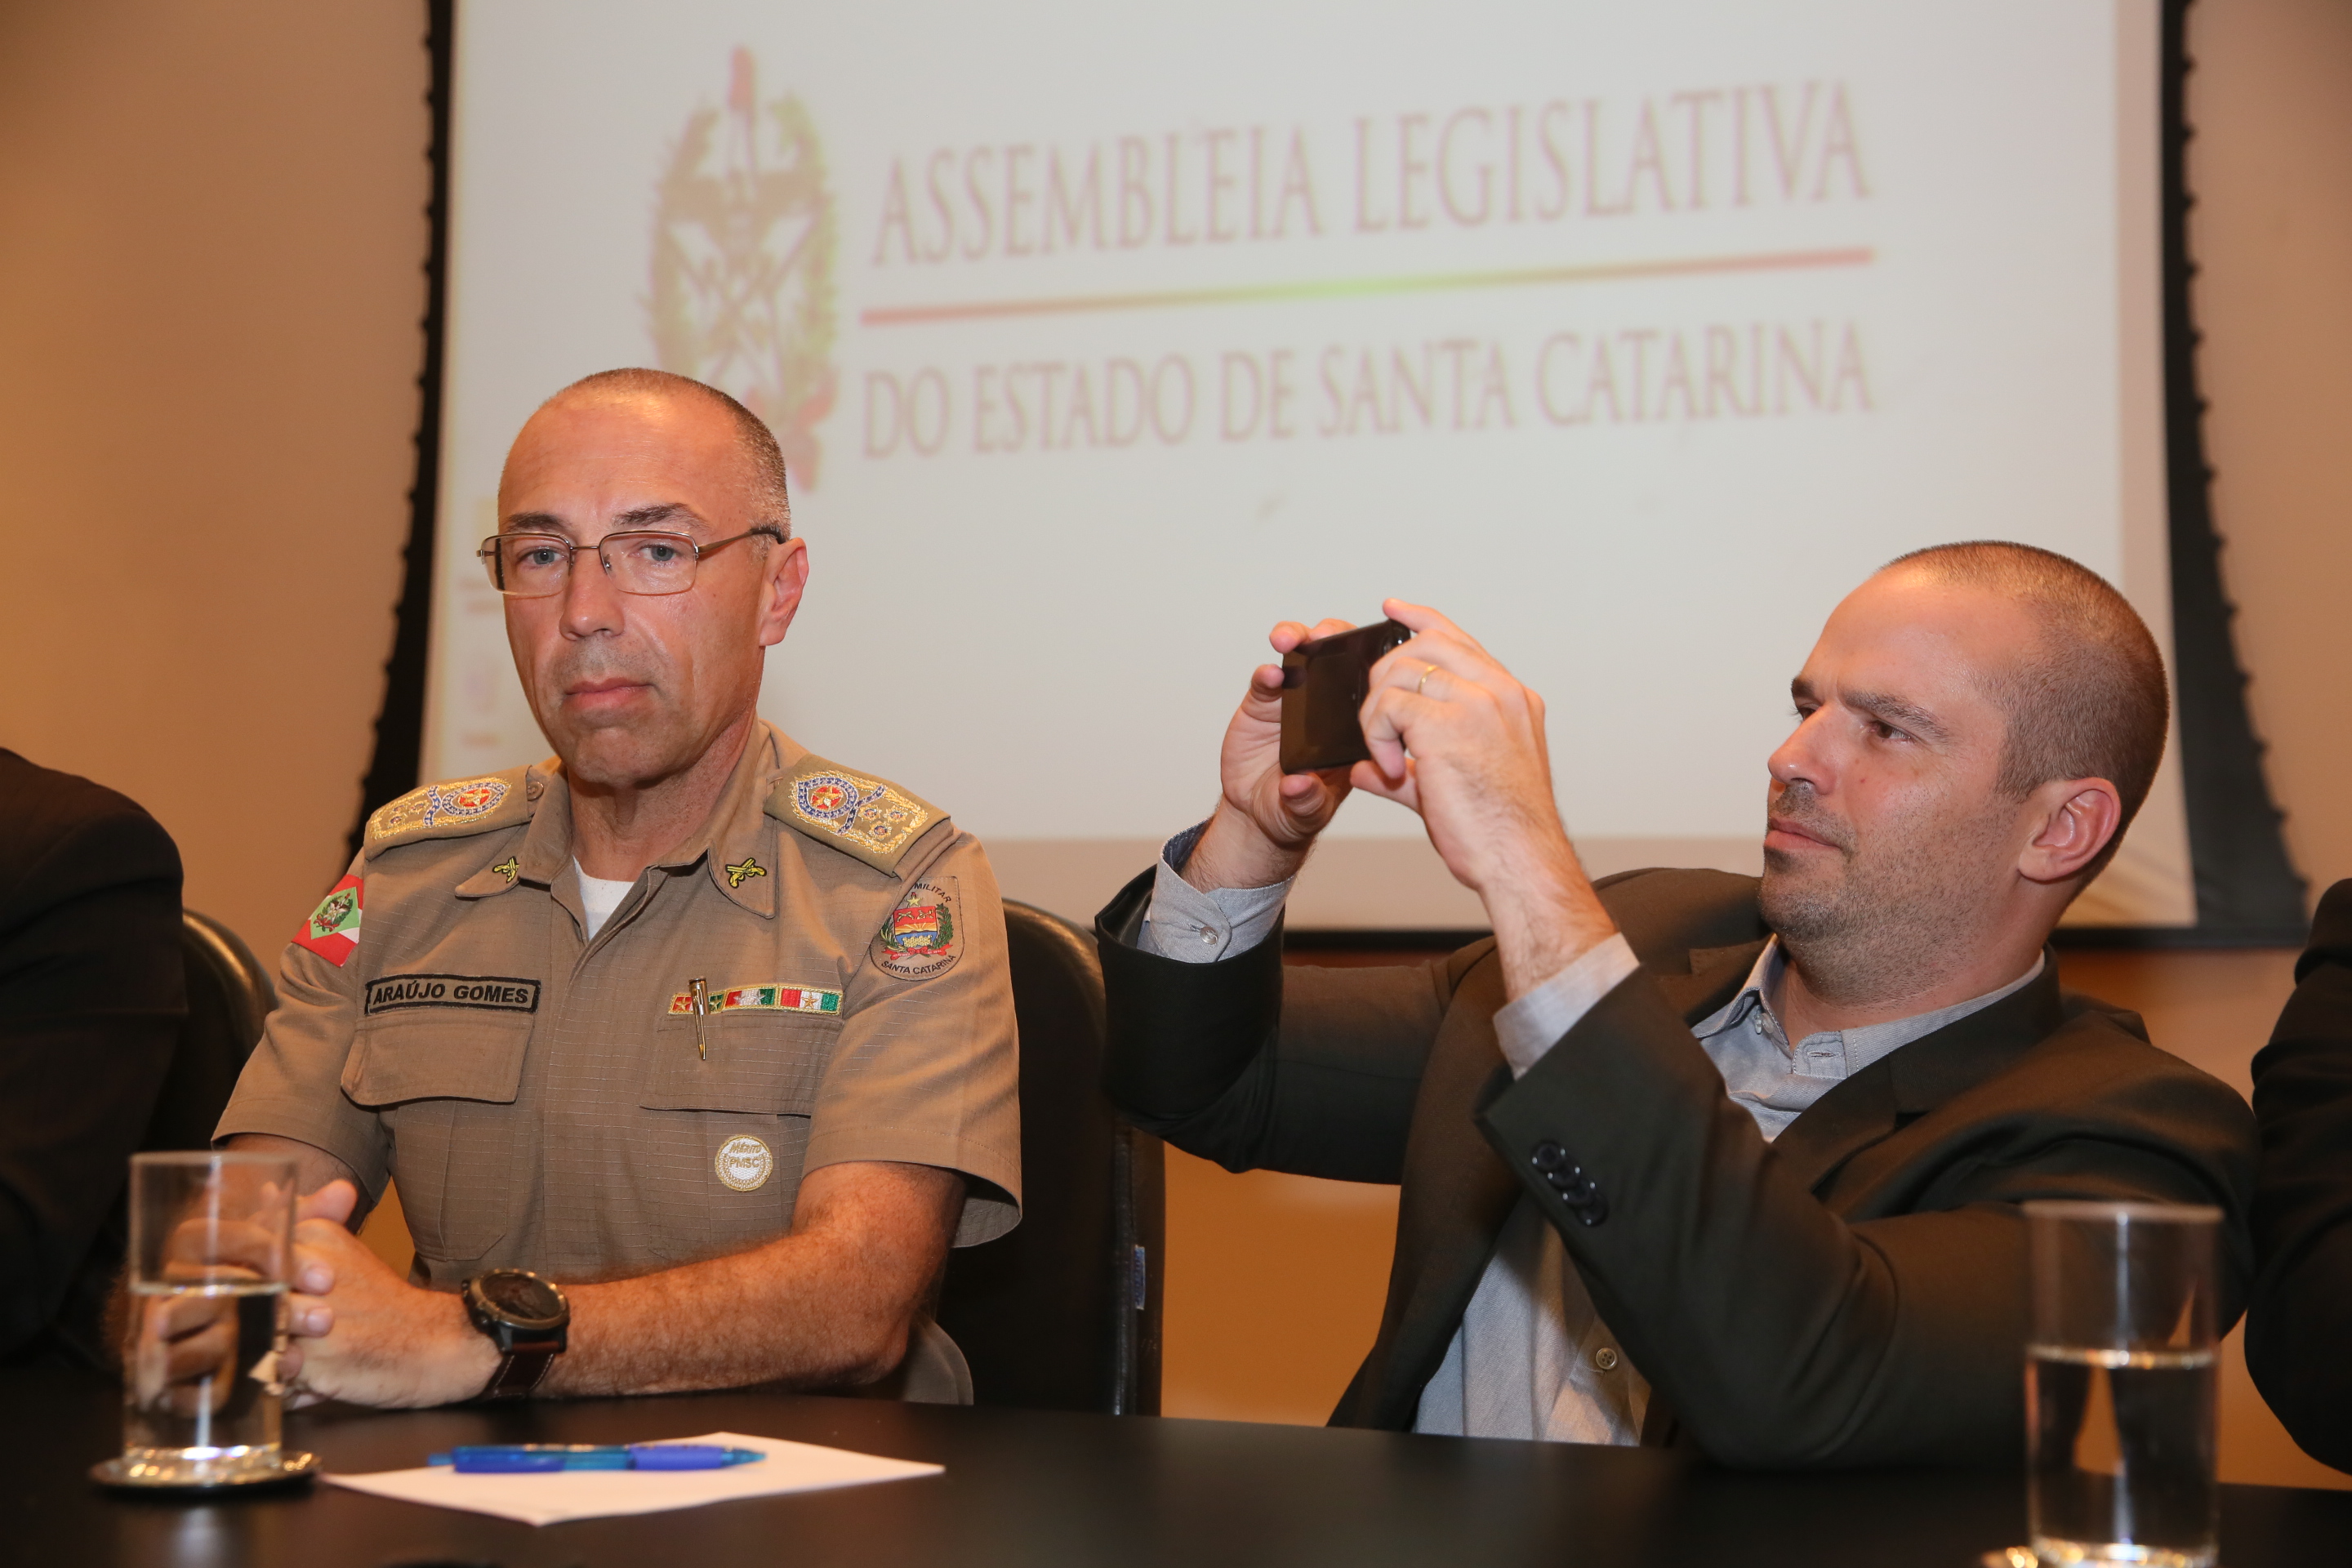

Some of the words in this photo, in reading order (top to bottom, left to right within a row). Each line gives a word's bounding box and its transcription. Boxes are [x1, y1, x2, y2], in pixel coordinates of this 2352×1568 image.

[1353, 78, 1874, 234] LEGISLATIVA
[862, 366, 953, 459] DO
[975, 353, 1198, 454] ESTADO
[1220, 348, 1297, 443] DE
[1320, 334, 1519, 436] SANTA
[1536, 318, 1876, 428] CATARINA
[914, 883, 951, 903] MILITAR
[881, 960, 910, 973] SANTA
[913, 955, 956, 974] CATARINA
[373, 980, 445, 1005] ARAÚJO
[453, 985, 528, 1004] GOMES
[729, 1156, 760, 1168] PMSC
